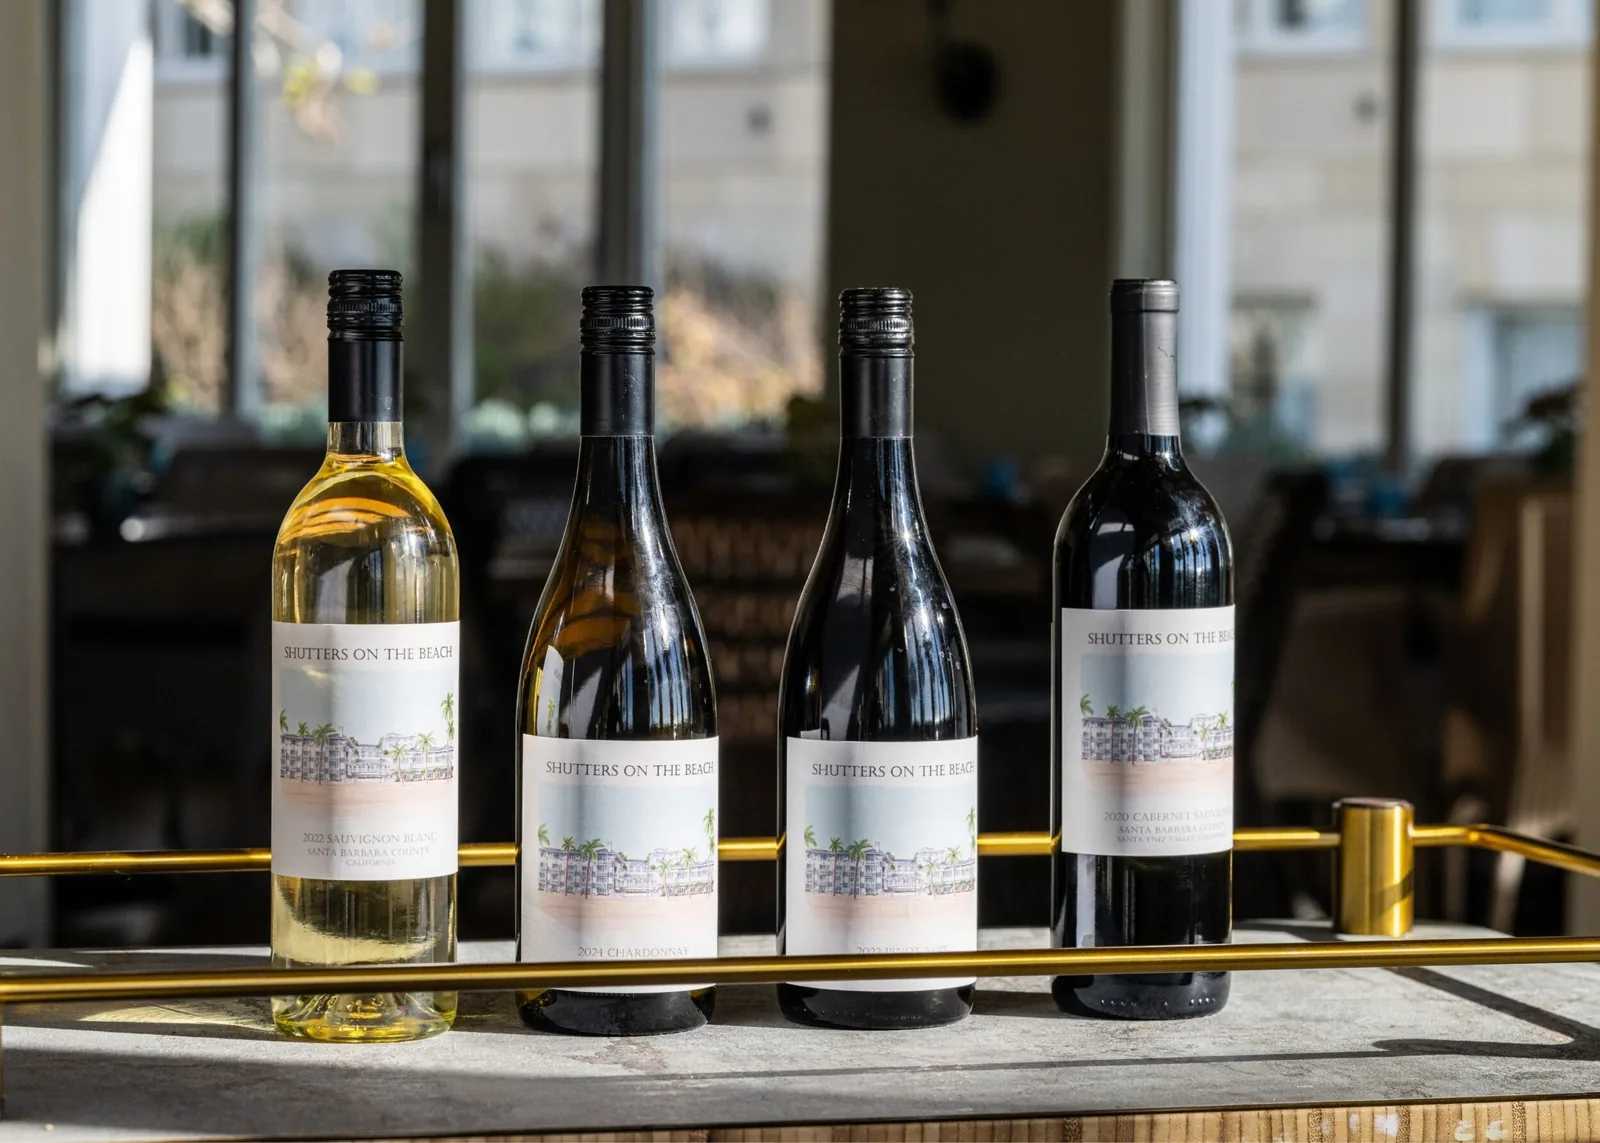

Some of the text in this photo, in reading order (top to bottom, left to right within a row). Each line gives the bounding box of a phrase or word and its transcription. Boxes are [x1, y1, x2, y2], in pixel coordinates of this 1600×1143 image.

[1088, 629, 1234, 645] SHUTTERS ON THE BEAC
[284, 645, 453, 661] SHUTTERS ON THE BEACH
[546, 761, 714, 777] SHUTTERS ON THE BEACH
[812, 761, 975, 778] SHUTTERS ON THE BEACH
[1103, 811, 1130, 821] 2020
[1133, 810, 1190, 821] CABERNET
[1119, 825, 1151, 834] SANTA
[1155, 824, 1197, 834] BARBARA
[302, 831, 437, 844] 2022 SAUVIGNON BLANC
[307, 846, 430, 857] SANTA BARBARA COUNTY
[346, 859, 396, 867] CALIFORNIA
[578, 945, 689, 958] 2024 CHARDONNAY
